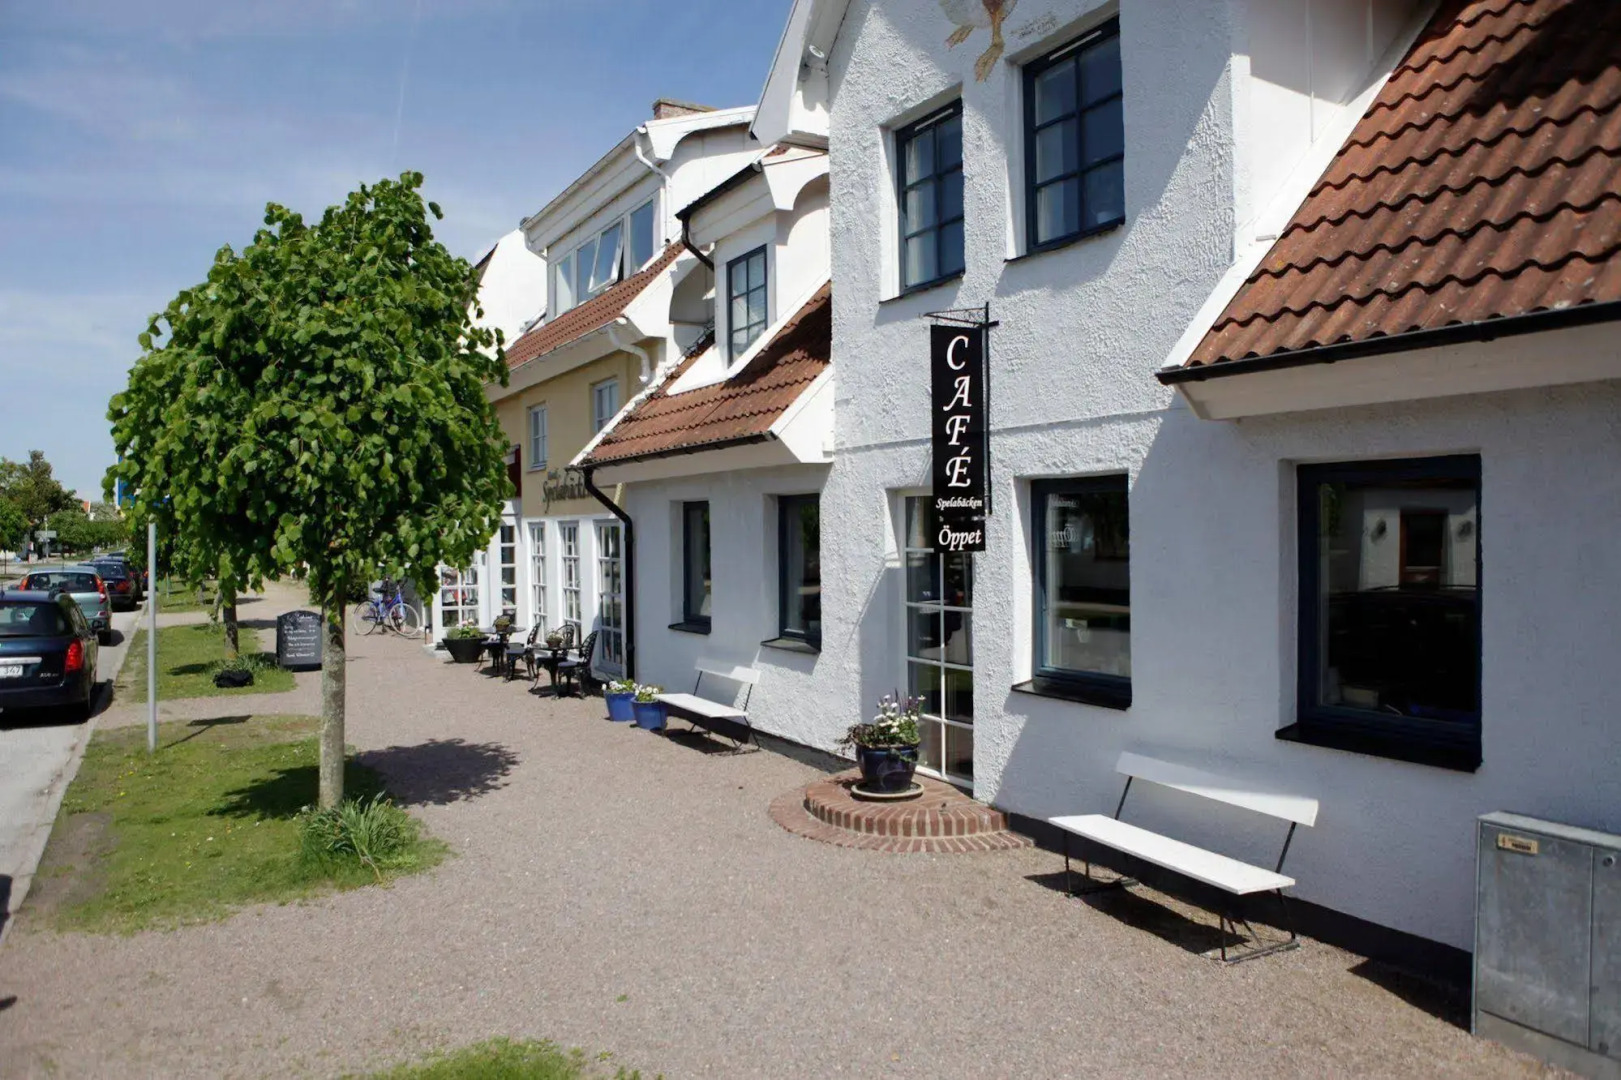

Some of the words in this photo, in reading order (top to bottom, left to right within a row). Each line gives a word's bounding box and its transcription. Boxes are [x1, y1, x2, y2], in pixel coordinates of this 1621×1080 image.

[942, 335, 972, 488] CAFÉ
[935, 497, 983, 510] Spelabäcken
[938, 525, 982, 550] Öppet
